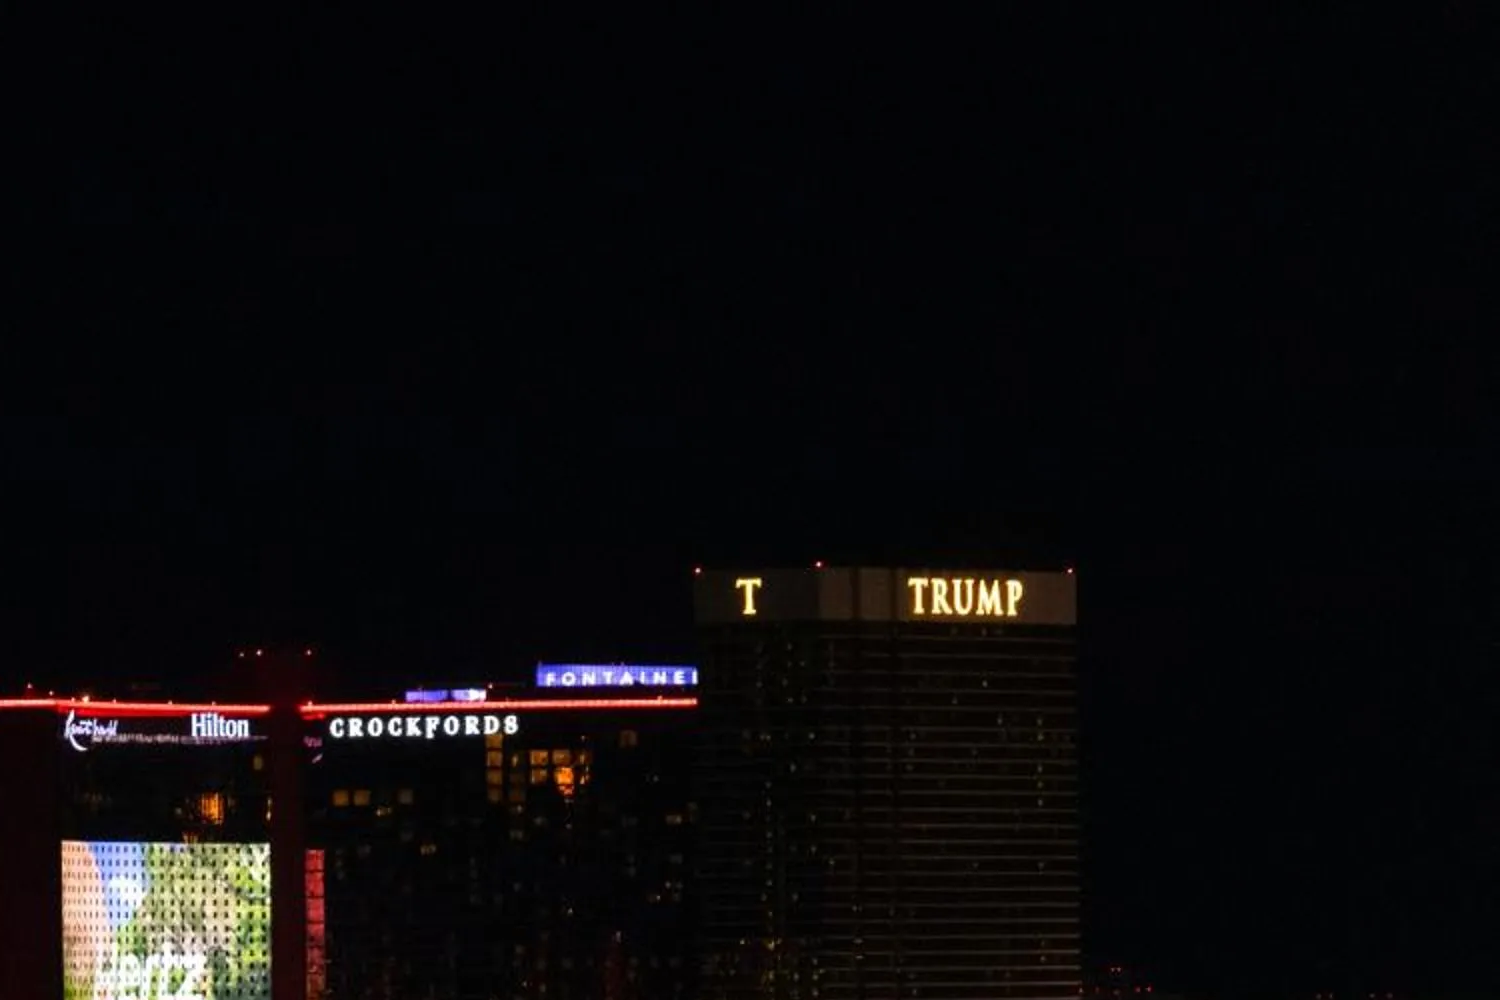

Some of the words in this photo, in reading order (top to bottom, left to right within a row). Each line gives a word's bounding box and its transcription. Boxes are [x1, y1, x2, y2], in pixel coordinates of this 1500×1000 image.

[735, 577, 762, 616] T
[908, 577, 1024, 616] TRUMP
[191, 712, 249, 738] Hilton
[328, 714, 521, 739] CROCKFORDS
